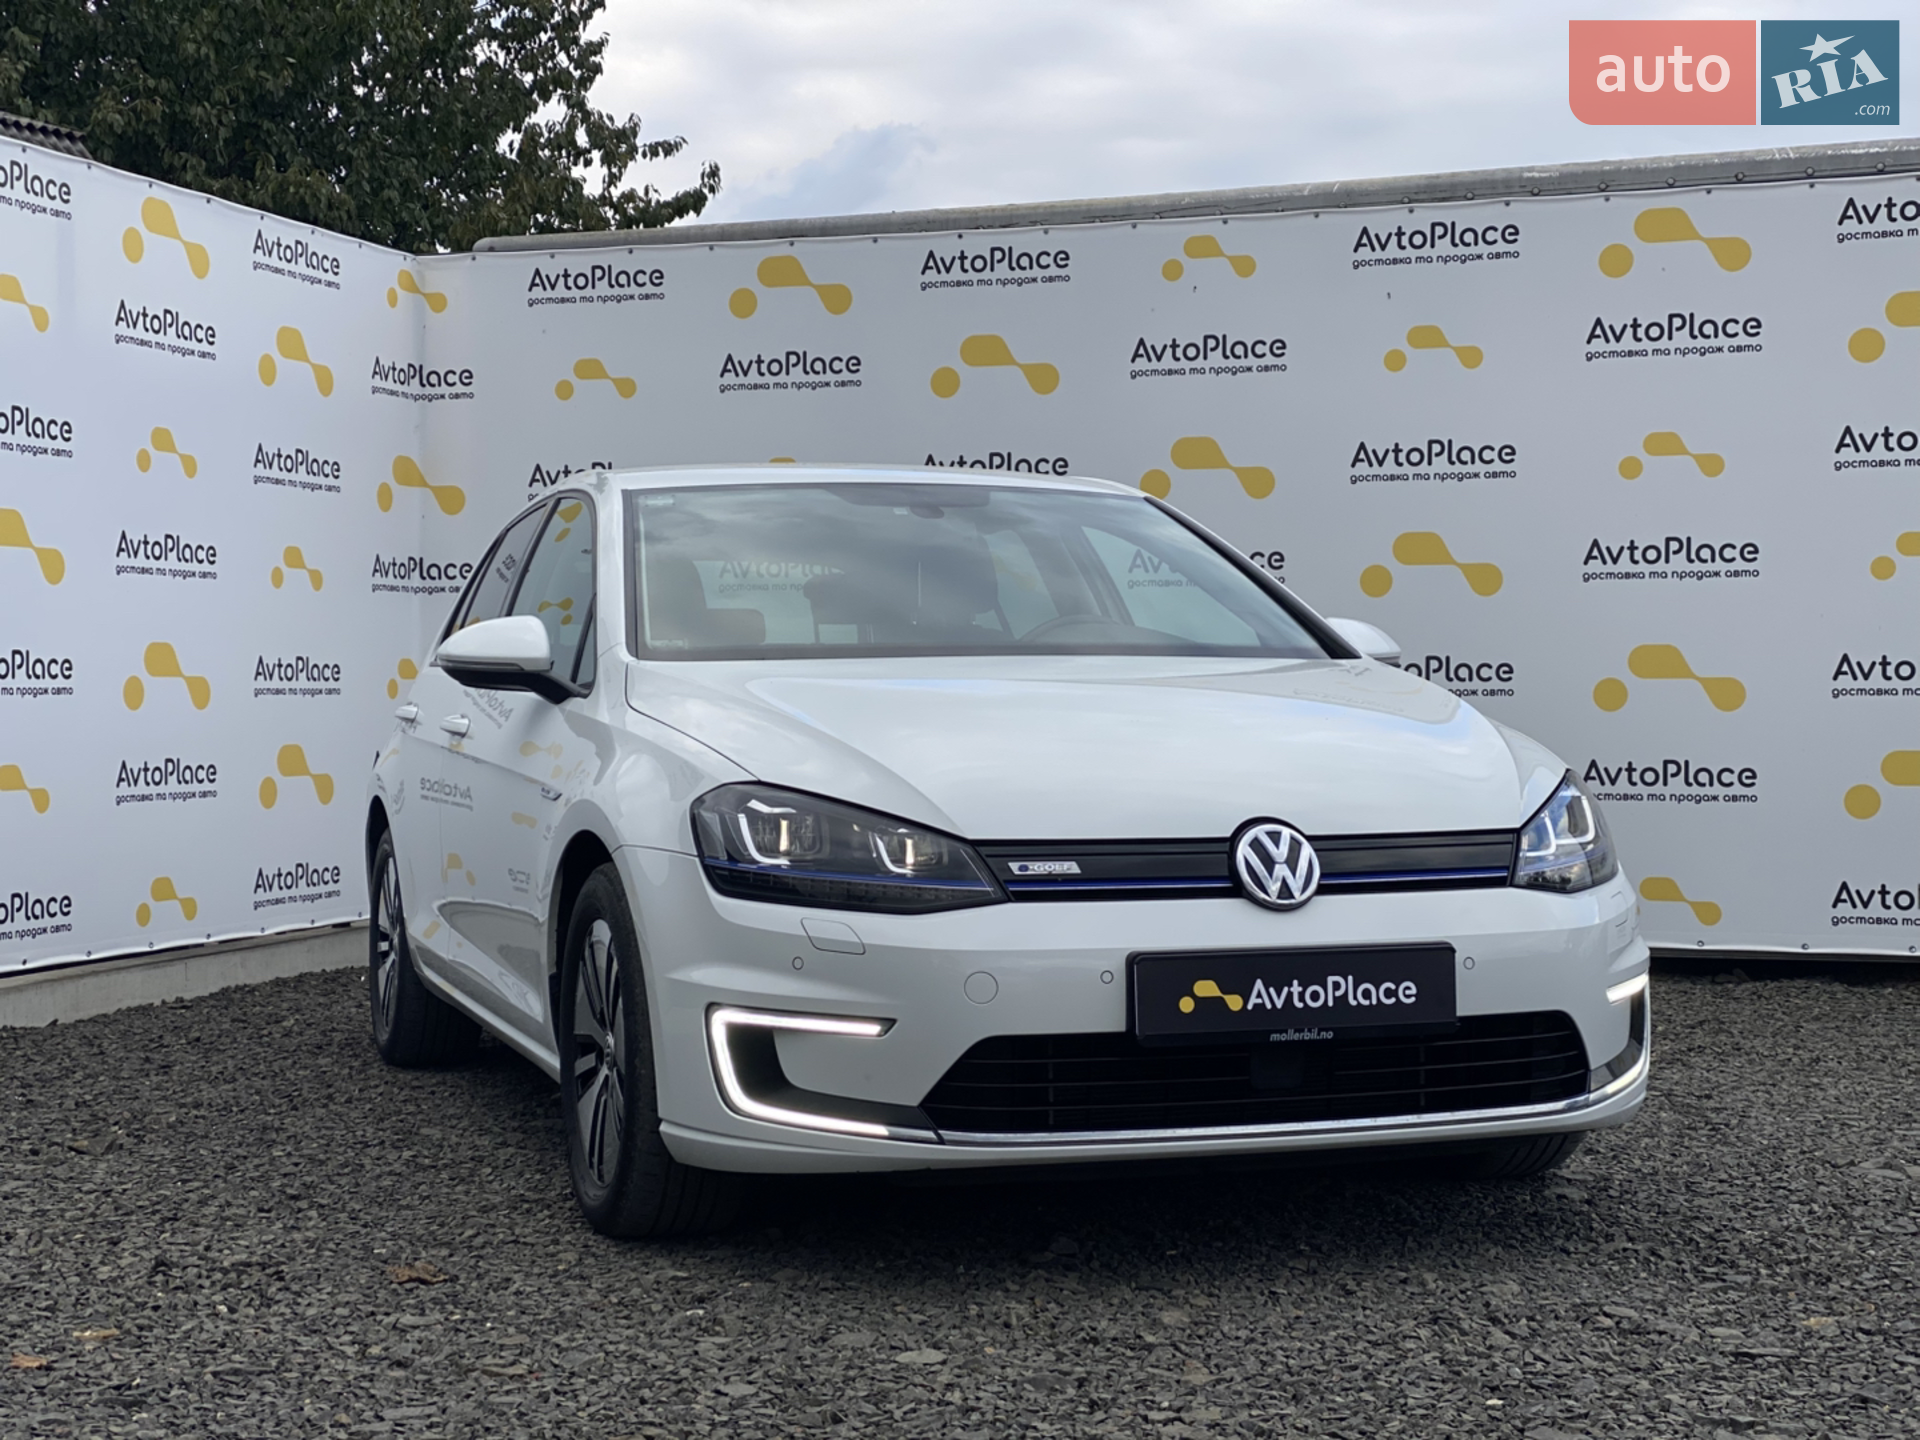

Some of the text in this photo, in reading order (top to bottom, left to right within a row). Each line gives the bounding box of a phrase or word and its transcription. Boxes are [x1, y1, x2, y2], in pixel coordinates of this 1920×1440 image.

[15, 199, 48, 215] продаж
[49, 208, 72, 221] авто
[1353, 221, 1520, 254] AvtoPlace
[1836, 229, 1904, 244] доставка
[253, 229, 340, 276] AvtoPlace
[920, 246, 1070, 276] AvtoPlace
[1352, 256, 1412, 270] доставка
[1436, 253, 1484, 265] продаж
[1486, 250, 1520, 260] авто
[528, 264, 665, 292] AvtoPlace
[920, 279, 974, 291] доставка
[995, 276, 1038, 288] продаж
[1040, 274, 1071, 283] авто
[527, 296, 577, 308] доставка
[596, 294, 635, 304] продаж
[637, 292, 665, 301] авто
[115, 299, 216, 346] AvtoPlace
[1586, 312, 1762, 345] AvtoPlace
[114, 333, 153, 349] доставка
[167, 344, 195, 358] продаж
[197, 350, 216, 361] авто
[1130, 334, 1287, 364] AvtoPlace
[1585, 349, 1649, 362] доставка
[1674, 345, 1724, 358] продаж
[1727, 344, 1763, 353] авто
[372, 356, 474, 387] AvtoPlace
[719, 350, 862, 378] AvtoPlace
[1130, 368, 1186, 380] доставка
[1209, 365, 1253, 376] продаж
[1256, 364, 1287, 373] авто
[719, 382, 770, 394] доставка
[791, 381, 831, 391] продаж
[833, 379, 862, 388] авто
[16, 443, 49, 457] продаж
[50, 448, 73, 458] авто
[253, 443, 341, 480] AvtoPlace
[1350, 438, 1517, 469] AvtoPlace
[1350, 473, 1409, 485] доставка
[1433, 471, 1481, 483] продаж
[1483, 470, 1517, 479] авто
[1834, 459, 1901, 472] доставка
[116, 530, 217, 566] AvtoPlace
[1583, 536, 1760, 566] AvtoPlace
[115, 565, 154, 576] доставка
[168, 568, 196, 580] продаж
[198, 571, 217, 580] авто
[372, 554, 473, 580] AvtoPlace
[1582, 571, 1646, 583] доставка
[1671, 570, 1721, 581] продаж
[1724, 569, 1760, 578] авто
[254, 655, 341, 682] AvtoPlace
[16, 687, 49, 698] продаж
[51, 687, 74, 695] авто
[1481, 688, 1515, 697] авто
[1831, 688, 1899, 699] доставка
[116, 758, 217, 788] AvtoPlace
[1583, 759, 1758, 788] AvtoPlace
[115, 793, 154, 806] доставка
[168, 791, 196, 802] продаж
[198, 790, 217, 799] авто
[1647, 793, 1666, 802] та
[1669, 793, 1719, 804] продаж
[1722, 794, 1758, 803] авто
[253, 862, 341, 894] AvtoPlace
[1831, 881, 1920, 911] Avto
[15, 927, 48, 940] продаж
[50, 923, 72, 934] авто
[1831, 916, 1898, 927] доставка
[1247, 974, 1417, 1010] AvtoPlace
[1270, 1028, 1334, 1042] mollerbil.no
